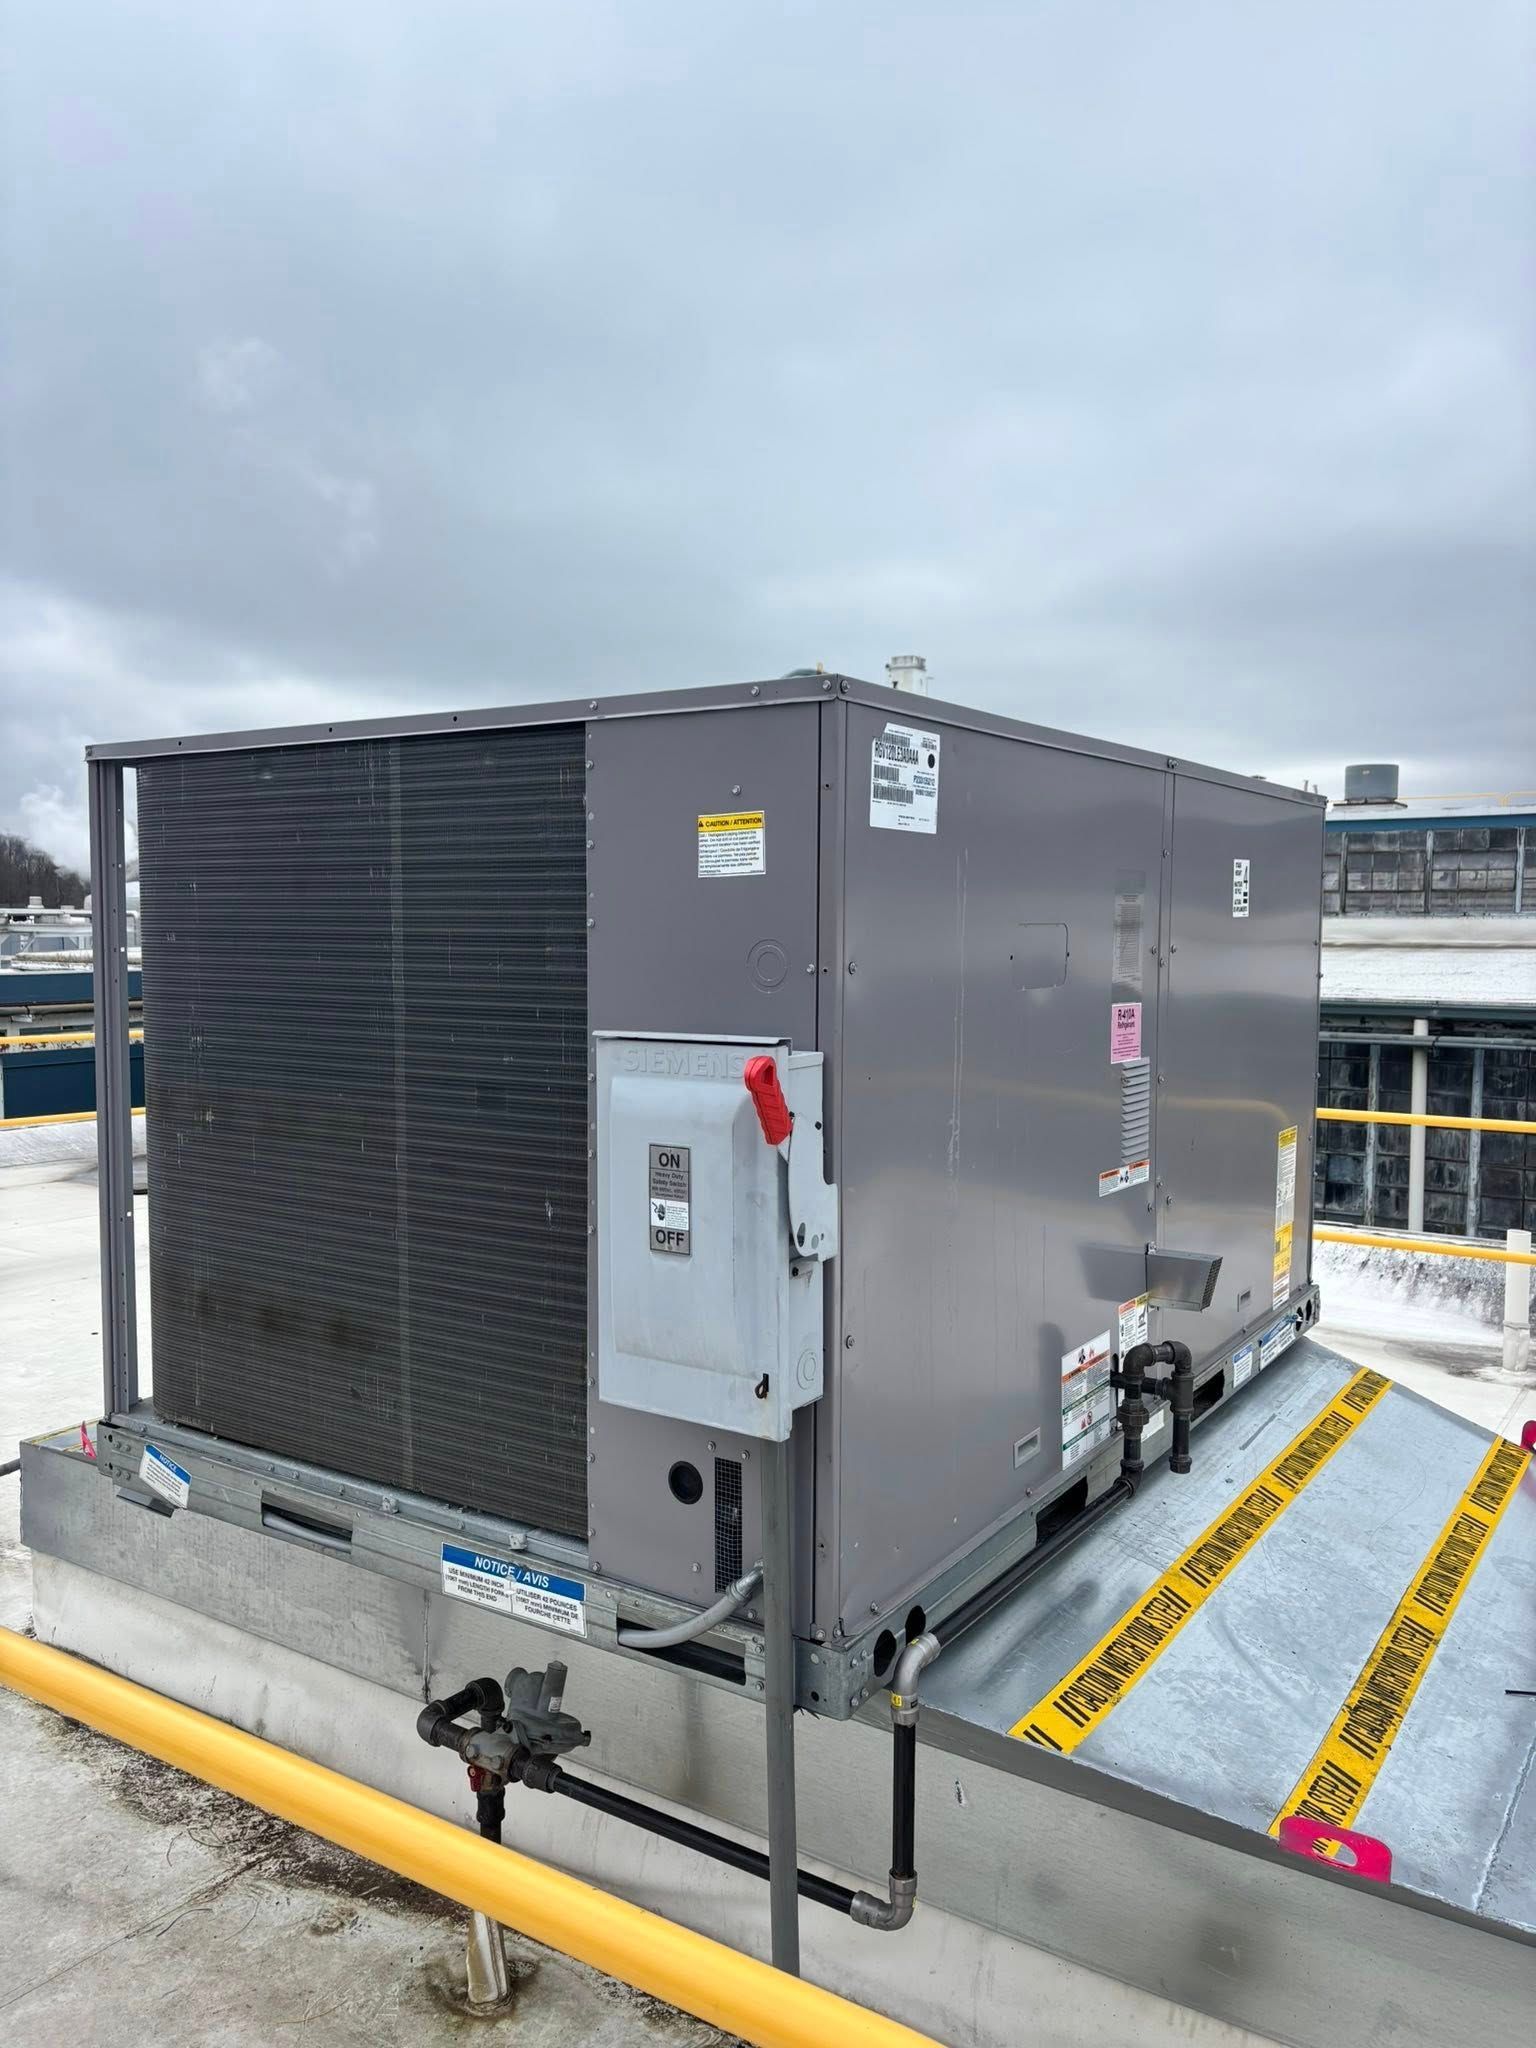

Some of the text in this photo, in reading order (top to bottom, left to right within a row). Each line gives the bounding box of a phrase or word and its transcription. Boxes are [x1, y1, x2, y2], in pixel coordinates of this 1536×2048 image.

[733, 817, 762, 825] ATTENTION
[1117, 1008, 1135, 1021] R-410A
[623, 1048, 745, 1081] SIEMENS
[658, 1152, 680, 1169] ON
[655, 1229, 685, 1246] OFF
[1277, 1453, 1317, 1480] CAUTION
[1319, 1417, 1349, 1435] STEP
[1187, 1493, 1278, 1577] CAUTION WATCH YOUR STEP
[474, 1556, 515, 1576] NOTICE
[522, 1572, 550, 1588] AVIS
[1418, 1521, 1486, 1605] CAUTION WATCH YOUR STEP
[448, 1567, 459, 1576] USE
[460, 1570, 483, 1582] MINIMUM
[491, 1580, 504, 1589] INCH
[470, 1582, 490, 1593] LENGTH
[457, 1585, 497, 1602] FROM THIS END
[516, 1588, 541, 1600] UTILISER
[524, 1605, 552, 1619] FOURCHE
[543, 1604, 570, 1617] MINIMUM
[570, 1612, 579, 1620] DE
[1063, 1597, 1183, 1713] CAUTION WATCH YOUR STEP
[1345, 1626, 1431, 1744] CAUTION WATCH YOUR STEP
[1307, 1775, 1355, 1816] STEP
